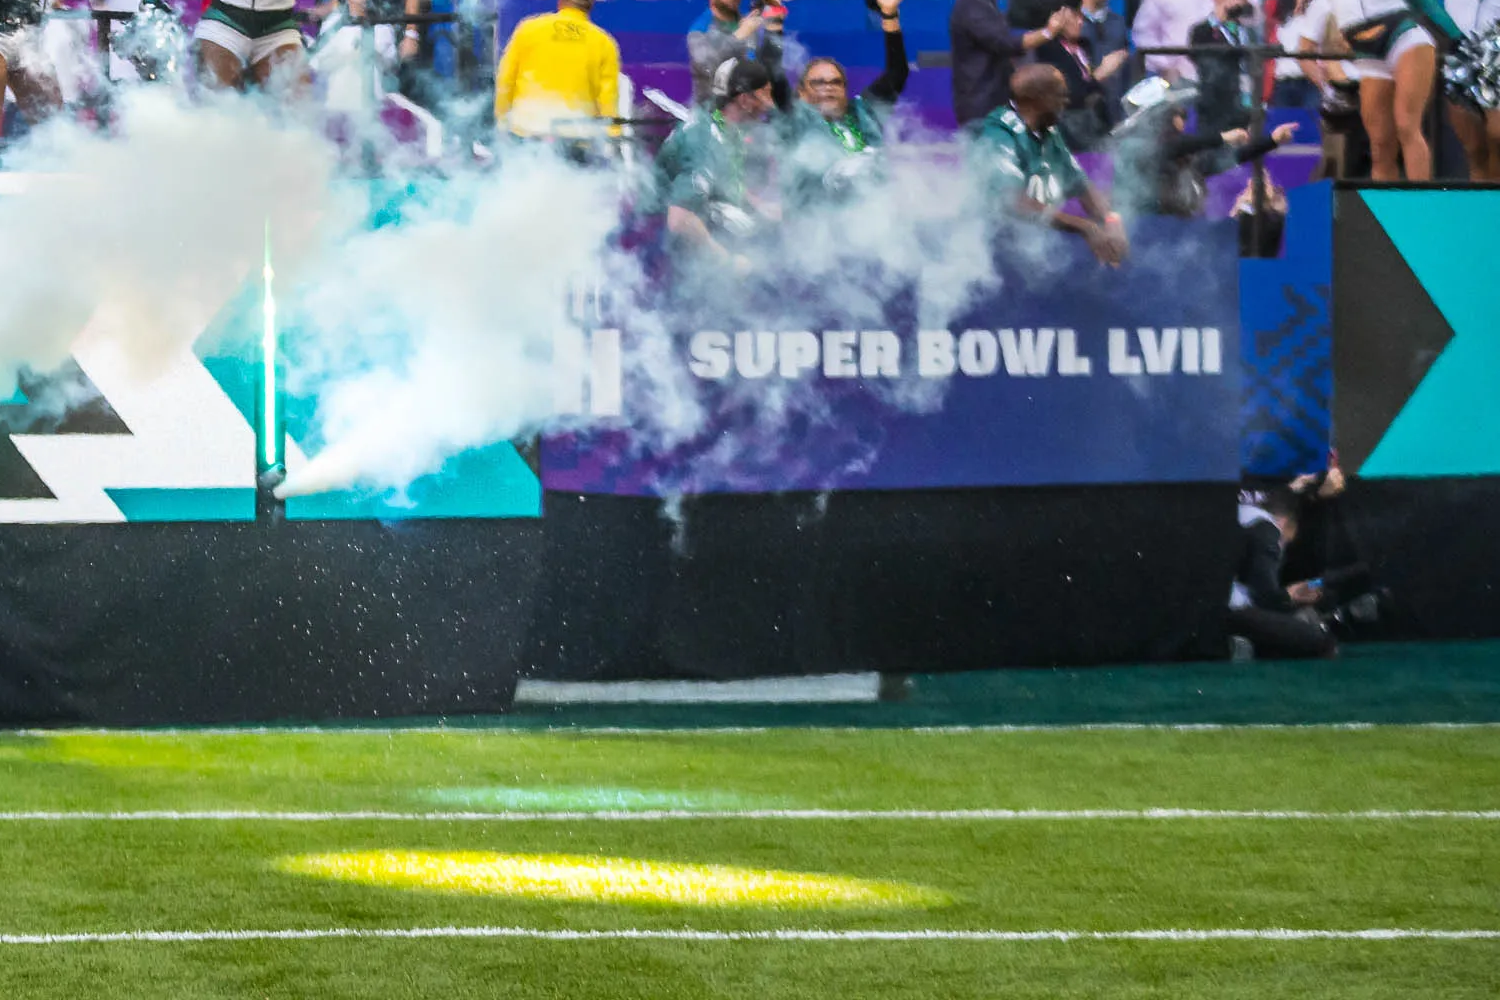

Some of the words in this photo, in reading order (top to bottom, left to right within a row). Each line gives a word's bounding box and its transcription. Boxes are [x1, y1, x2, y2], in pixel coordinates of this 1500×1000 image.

[689, 329, 901, 379] SUPER
[917, 328, 1092, 377] BOWL
[1107, 327, 1222, 375] LVII
